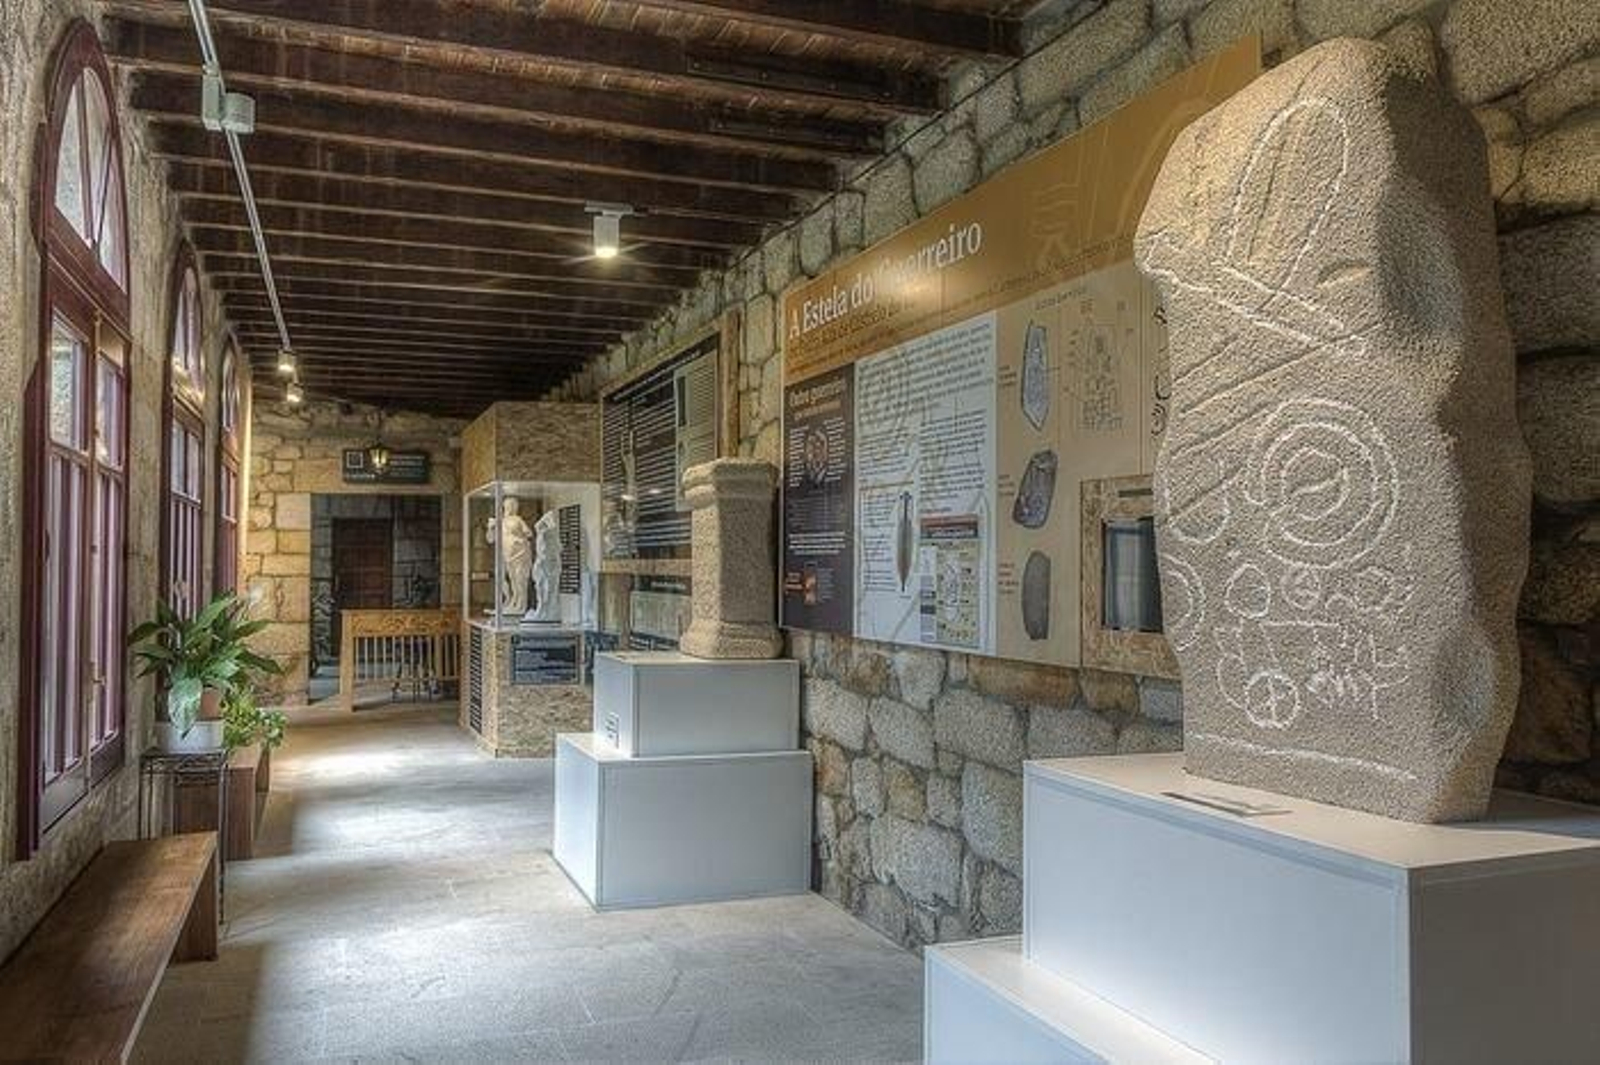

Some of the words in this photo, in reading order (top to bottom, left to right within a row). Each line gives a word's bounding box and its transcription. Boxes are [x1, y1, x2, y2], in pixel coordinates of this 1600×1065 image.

[789, 308, 800, 340] A
[802, 285, 848, 332] Estela
[851, 271, 874, 309] do
